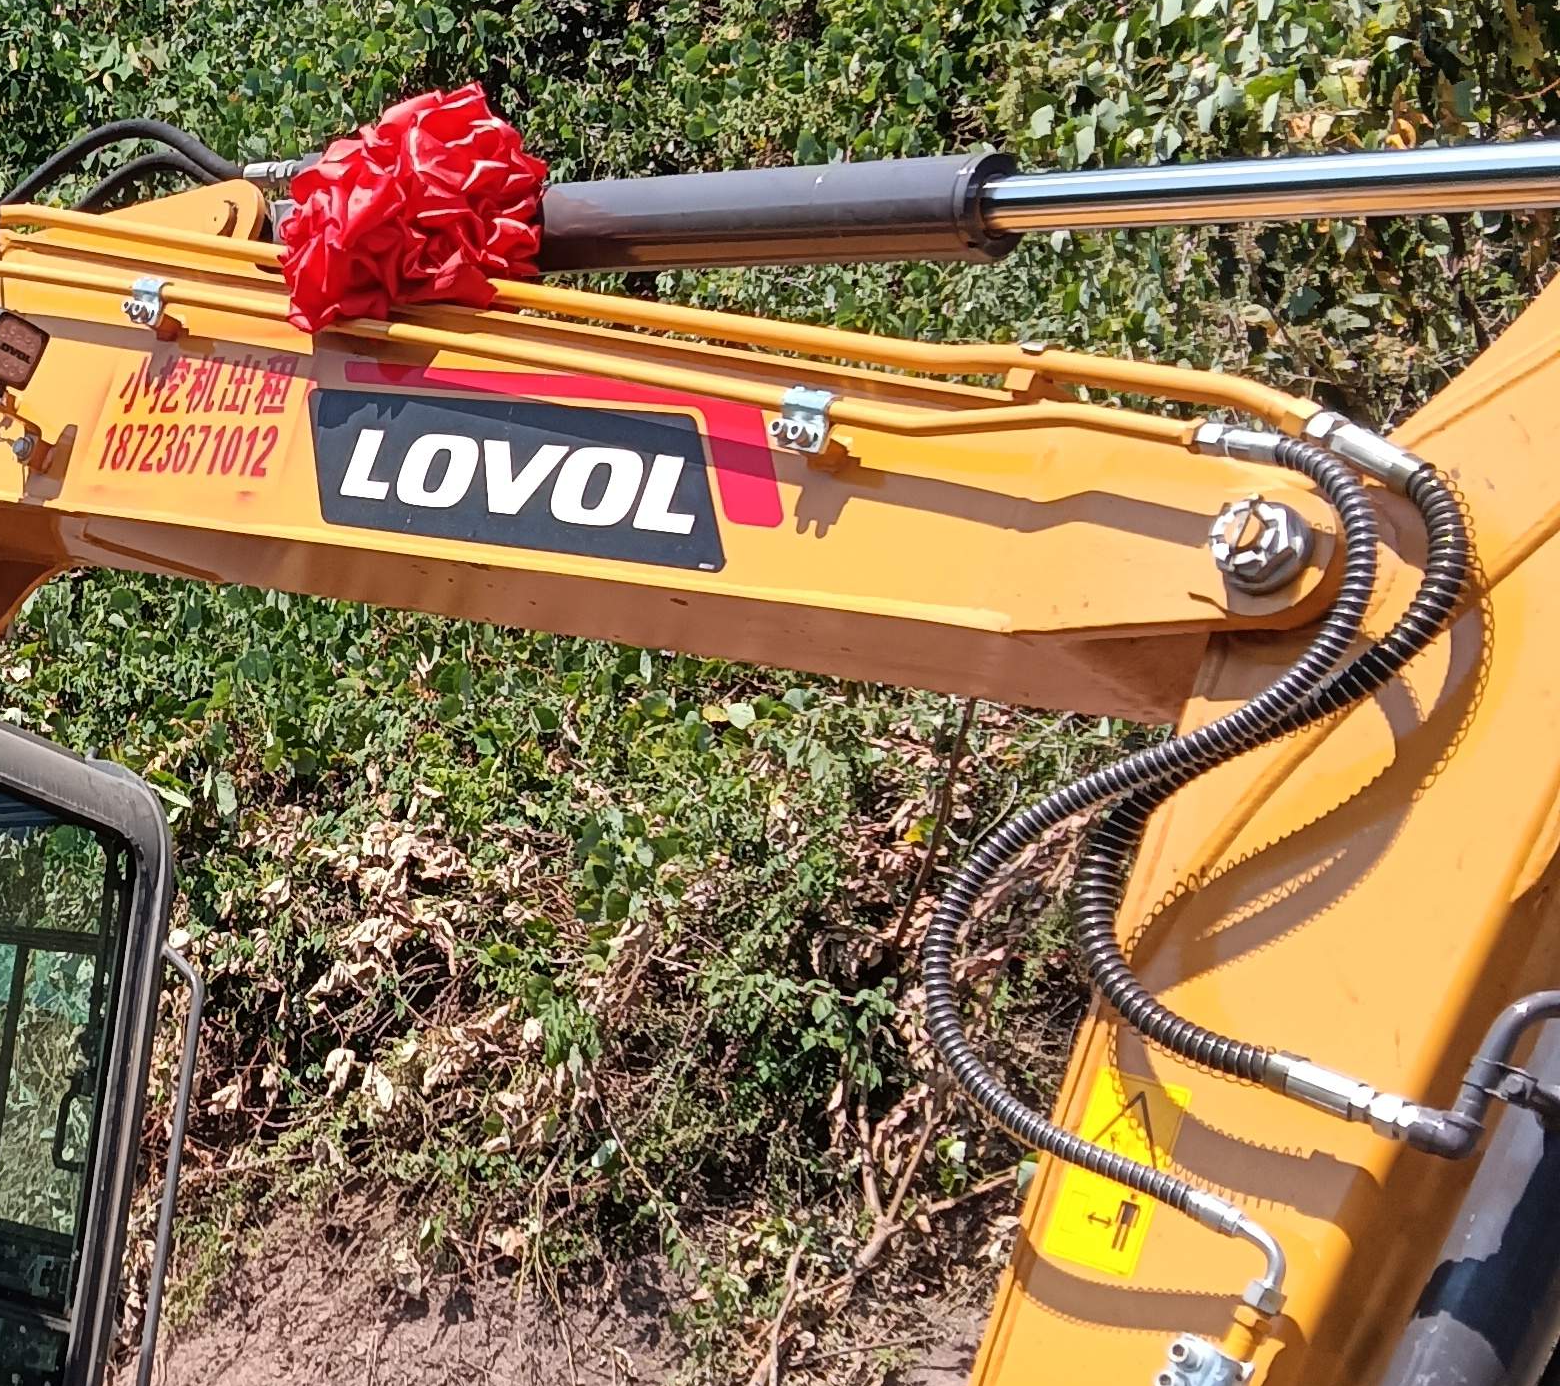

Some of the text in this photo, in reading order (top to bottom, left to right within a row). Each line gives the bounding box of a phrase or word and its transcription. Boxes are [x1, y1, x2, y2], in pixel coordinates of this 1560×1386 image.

[119, 354, 299, 415] 小挖机出租
[98, 423, 279, 477] 18723671012
[340, 429, 695, 535] LOVOL
